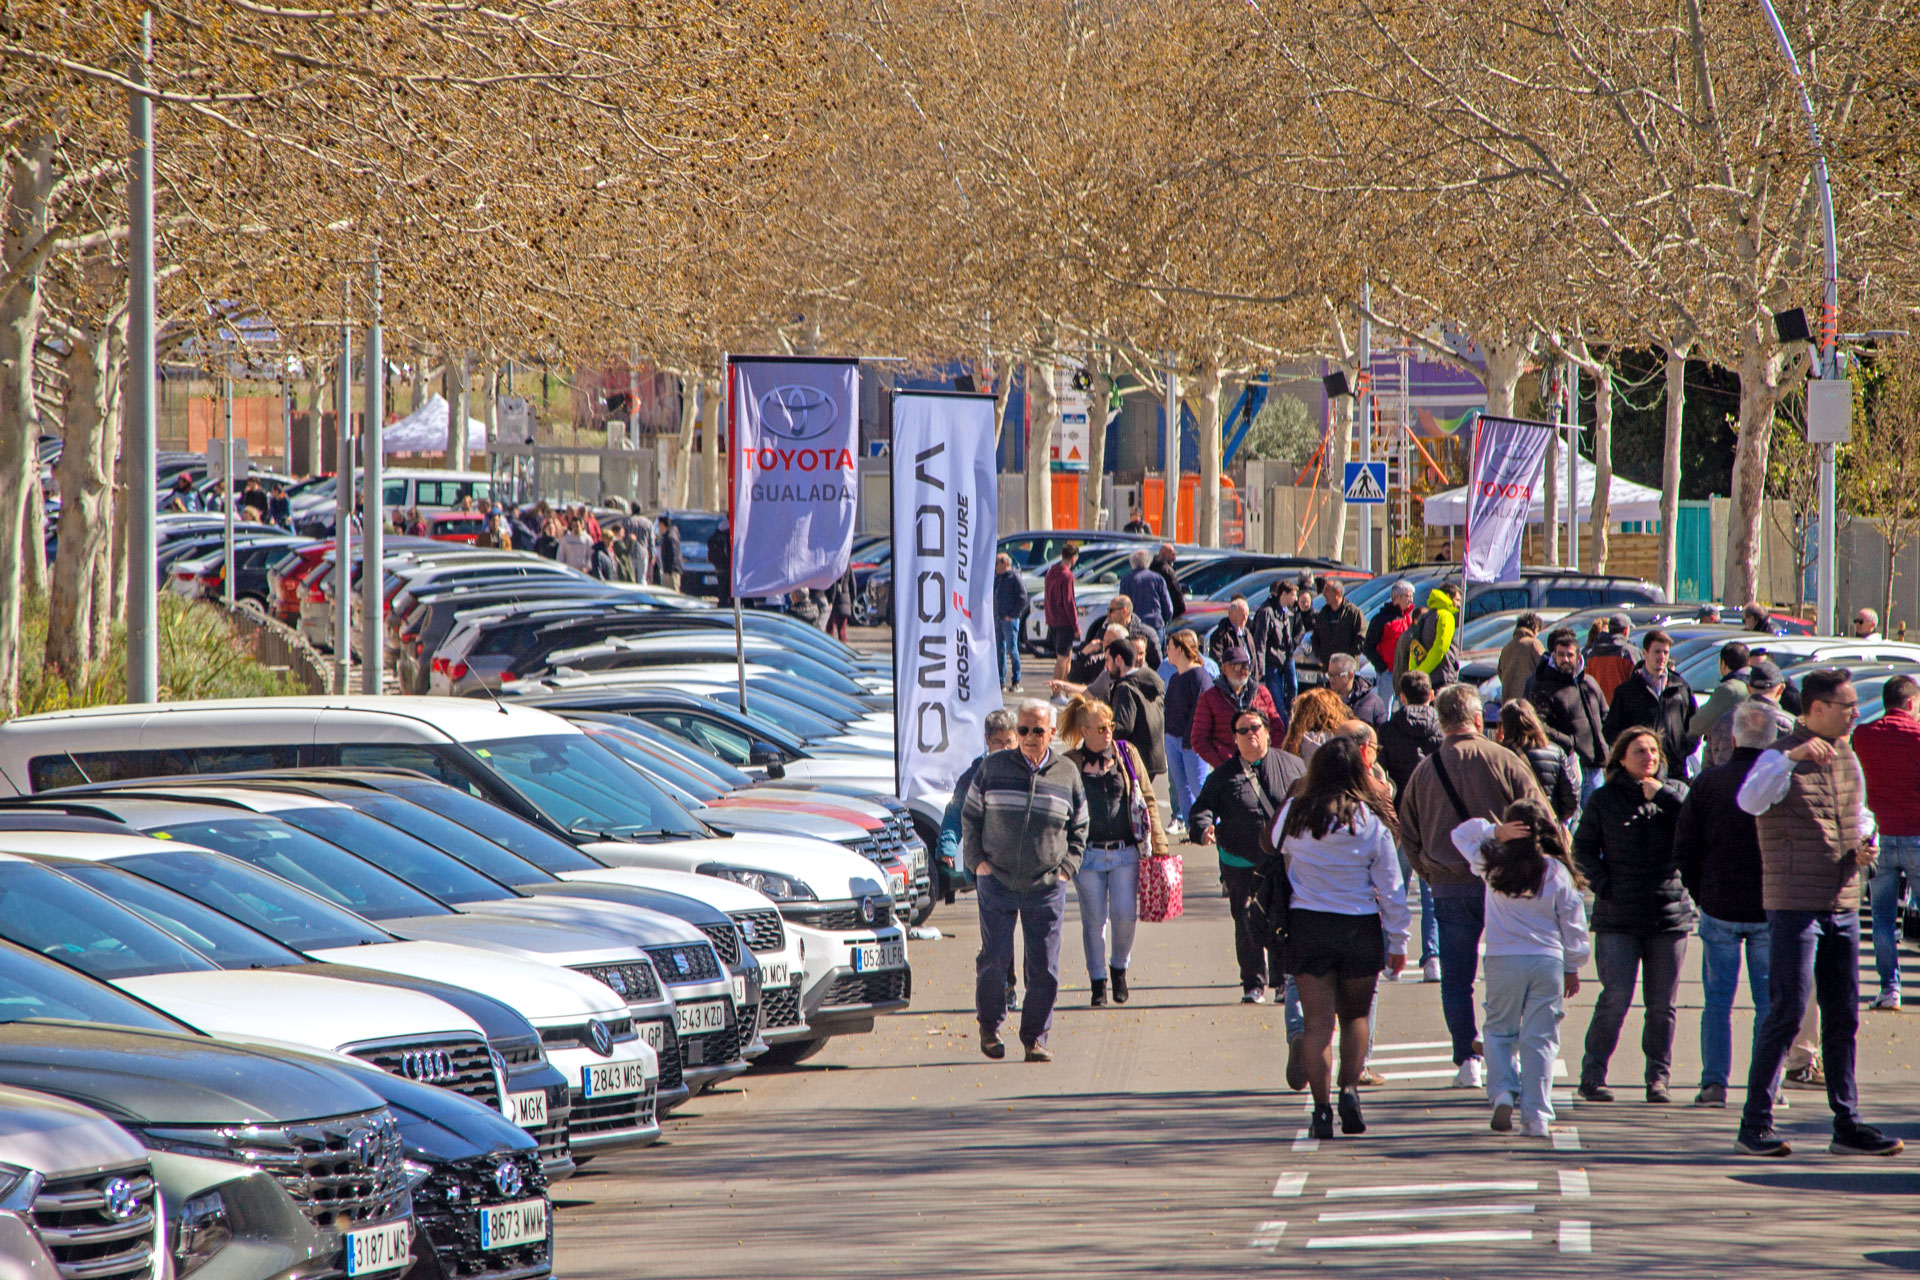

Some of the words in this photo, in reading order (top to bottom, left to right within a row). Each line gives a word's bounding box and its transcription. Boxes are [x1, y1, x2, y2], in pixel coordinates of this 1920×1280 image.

[742, 447, 855, 472] TOYOTA
[745, 483, 855, 502] IGUALADA
[1476, 480, 1531, 501] TOYOTA
[957, 491, 969, 583] FUTURE
[915, 441, 950, 754] OMODA
[956, 627, 971, 703] CROSS
[863, 947, 885, 968] 0523
[887, 944, 903, 965] LFG
[770, 964, 788, 983] MCV
[704, 1005, 723, 1027] KZD
[593, 1067, 621, 1093] 2843
[623, 1064, 643, 1089] MGS
[519, 1095, 544, 1122] MGK
[490, 1209, 520, 1241] 8673
[523, 1204, 543, 1237] MMM
[355, 1233, 384, 1268] 3187
[386, 1228, 406, 1263] LMS
